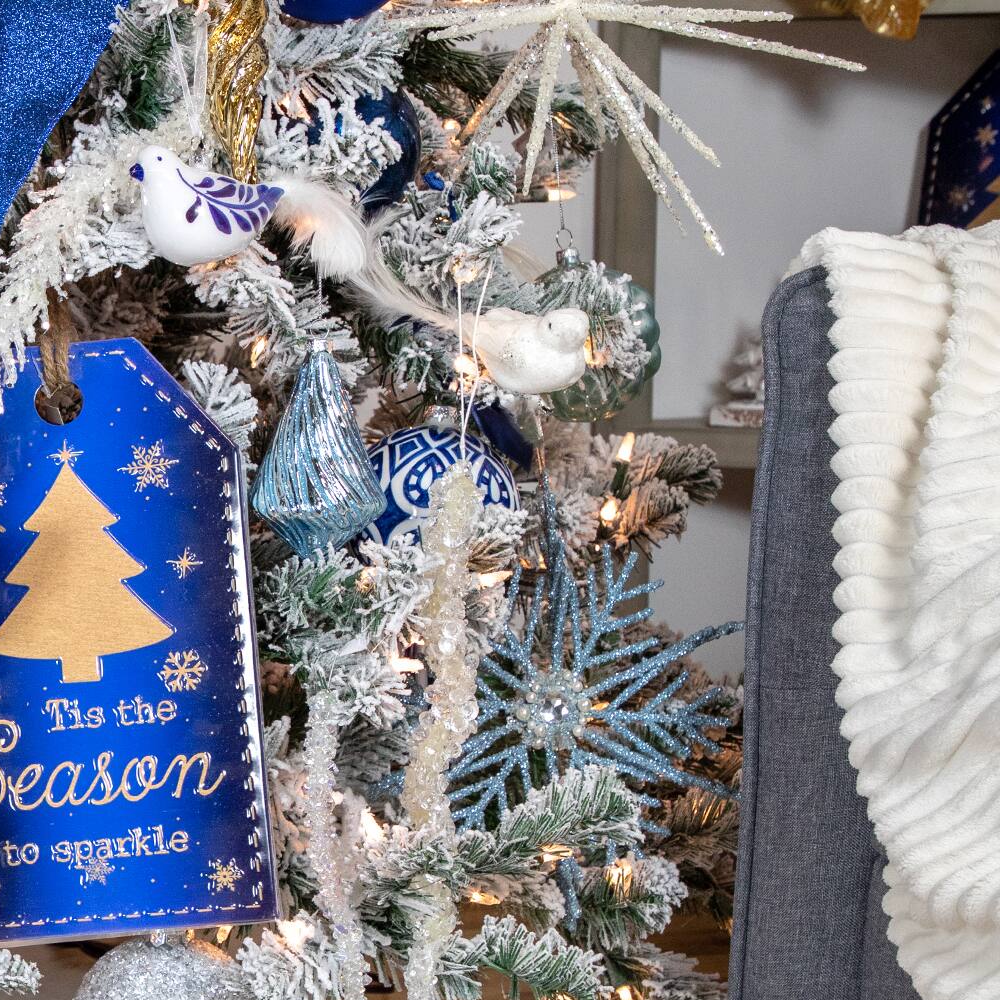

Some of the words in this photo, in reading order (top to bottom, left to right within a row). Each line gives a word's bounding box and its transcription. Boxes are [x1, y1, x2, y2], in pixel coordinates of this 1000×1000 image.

[44, 697, 104, 732] Tis
[117, 695, 177, 726] the
[2, 839, 40, 867] to
[53, 824, 190, 870] sparkle
